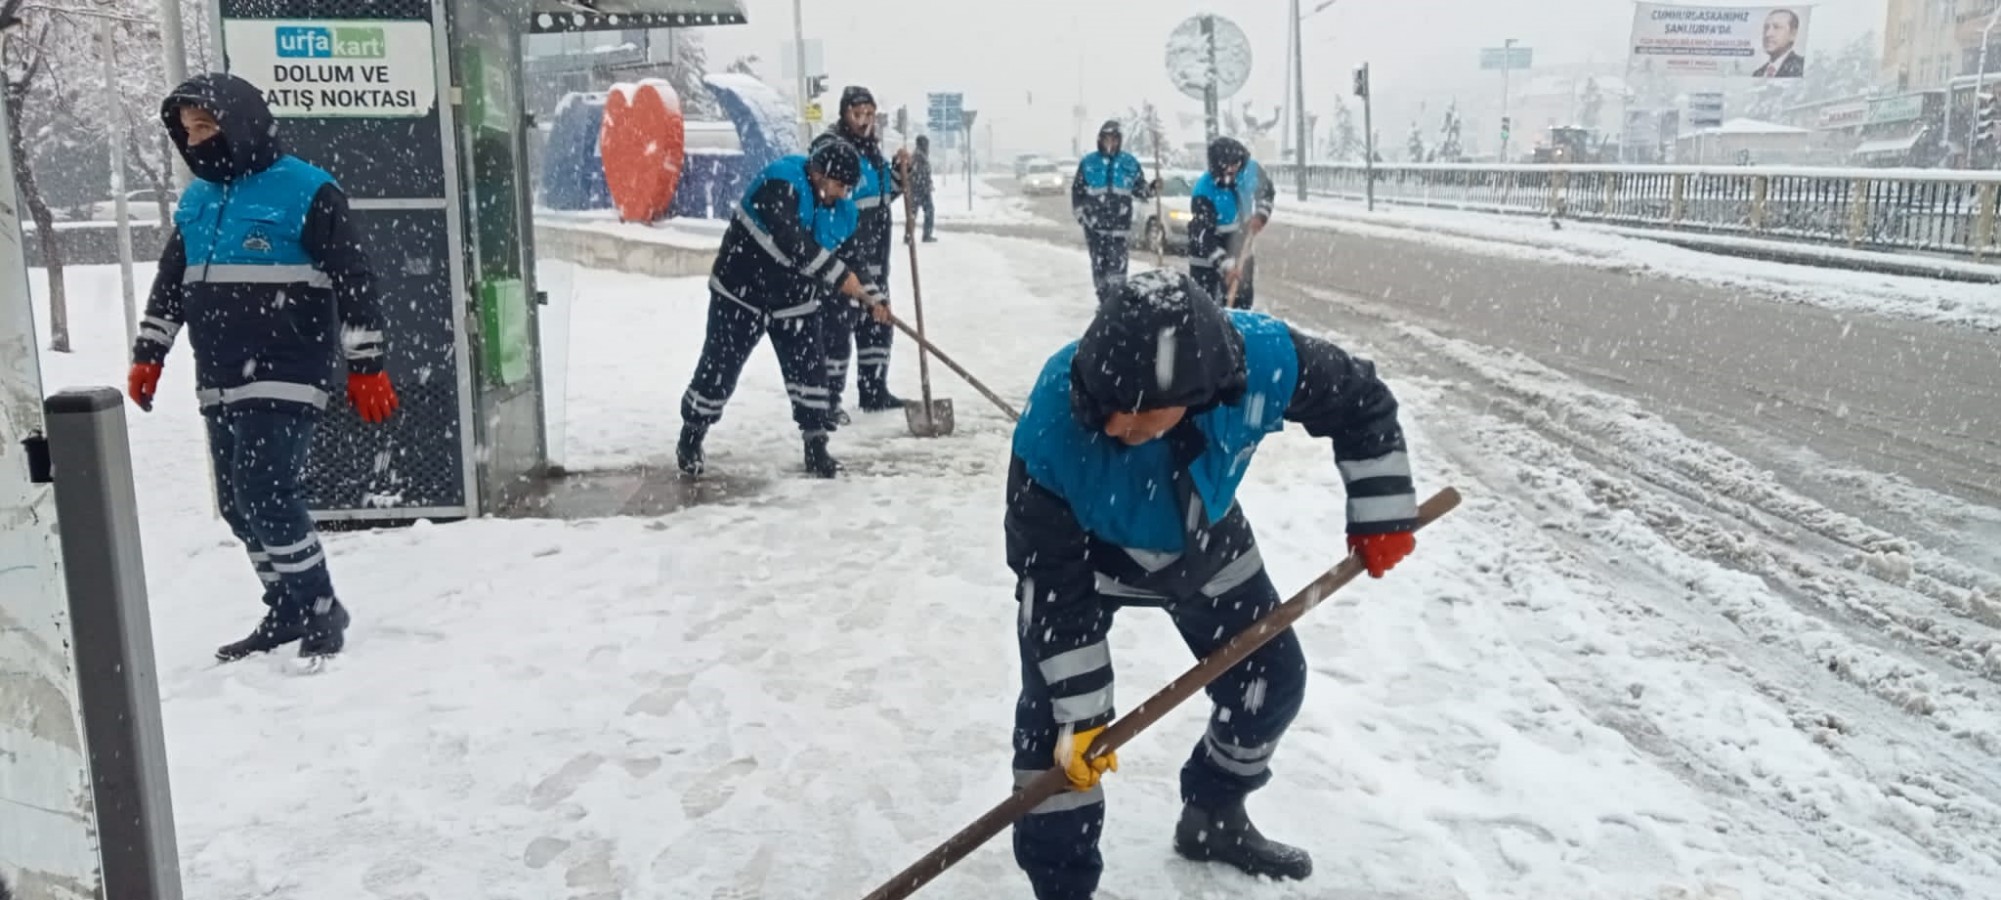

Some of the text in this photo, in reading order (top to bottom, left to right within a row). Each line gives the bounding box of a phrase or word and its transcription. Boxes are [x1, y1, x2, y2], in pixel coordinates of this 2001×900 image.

[274, 65, 389, 82] DOLUM VE
[261, 89, 416, 111] ATIŞ NOKTASI
